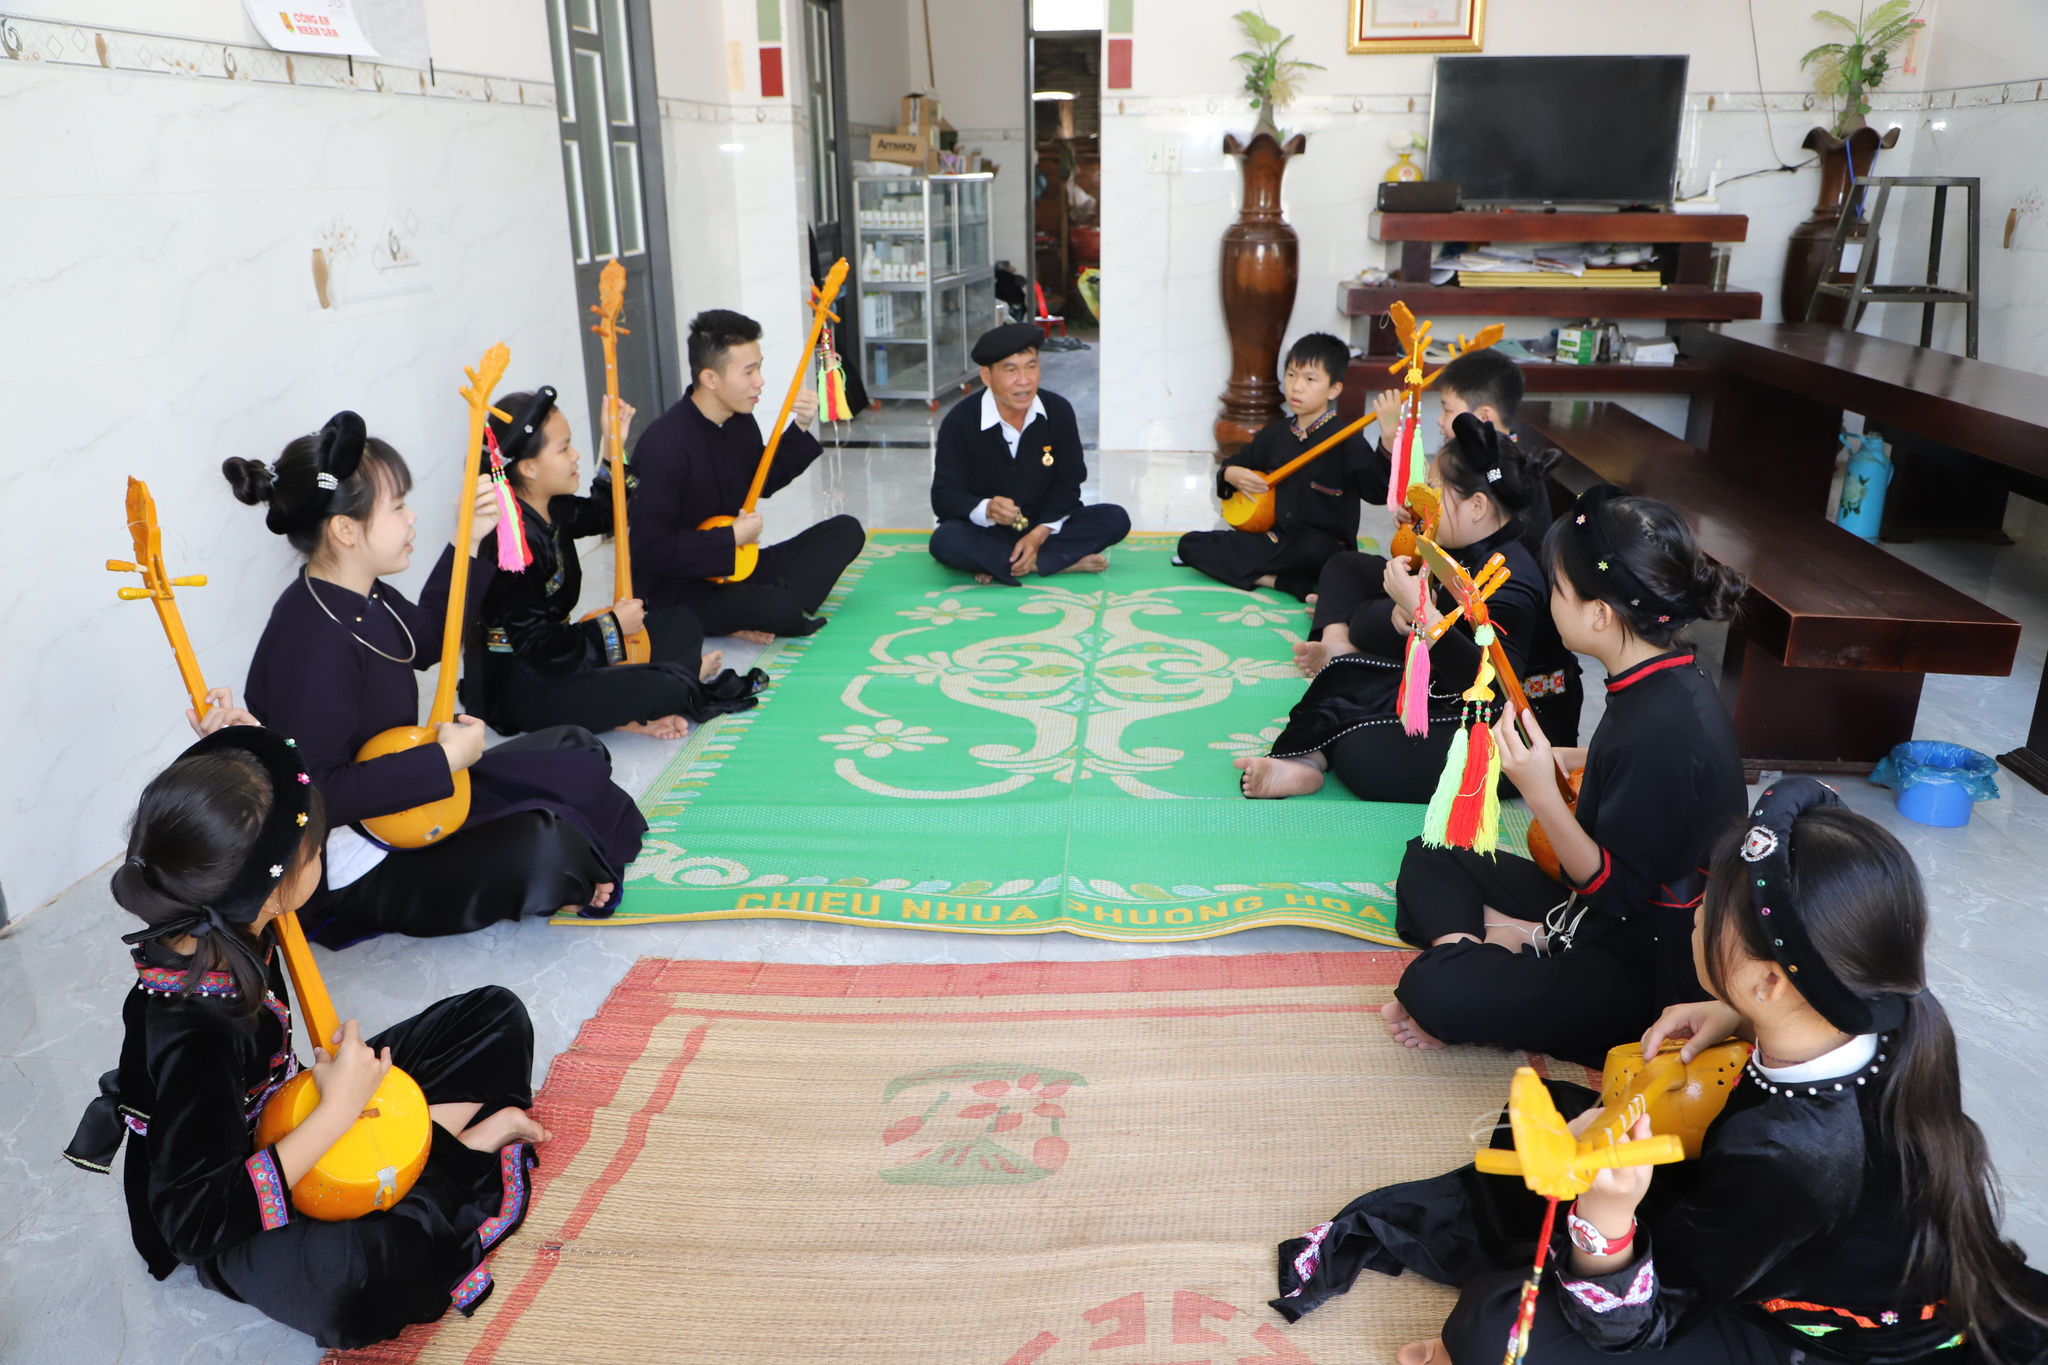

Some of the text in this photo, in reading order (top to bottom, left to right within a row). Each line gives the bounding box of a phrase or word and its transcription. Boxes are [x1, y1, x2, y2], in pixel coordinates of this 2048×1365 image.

[318, 15, 330, 26] AN
[877, 139, 917, 153] Amway
[734, 891, 881, 916] CHIEU
[901, 898, 1038, 922] NHUA
[1285, 893, 1388, 923] HOA
